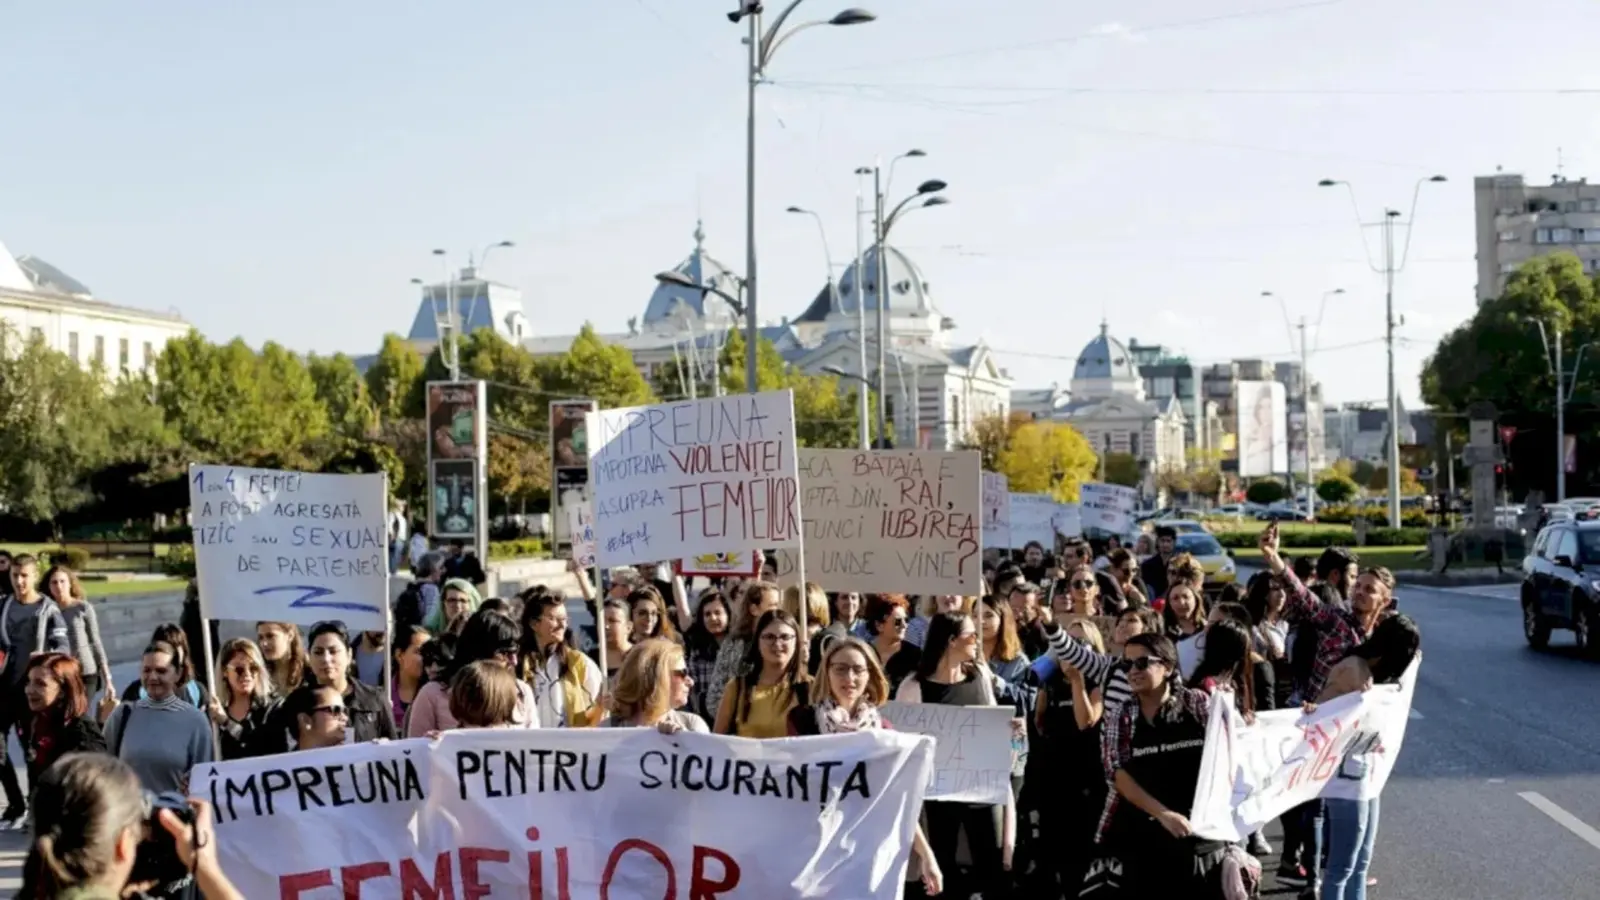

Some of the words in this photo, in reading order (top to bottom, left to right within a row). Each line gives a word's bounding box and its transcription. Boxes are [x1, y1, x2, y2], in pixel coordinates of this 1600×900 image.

[193, 470, 204, 493] 1
[225, 468, 235, 492] 4
[938, 457, 957, 478] E
[201, 501, 212, 517] A
[597, 488, 666, 521] ASUPRA
[802, 514, 864, 540] TUNCI
[880, 502, 979, 540] IUBIREA
[237, 555, 262, 573] DE
[821, 549, 875, 576] UNDE
[208, 749, 425, 825] ÎMPREUNĂ
[456, 749, 608, 801] PENTRU
